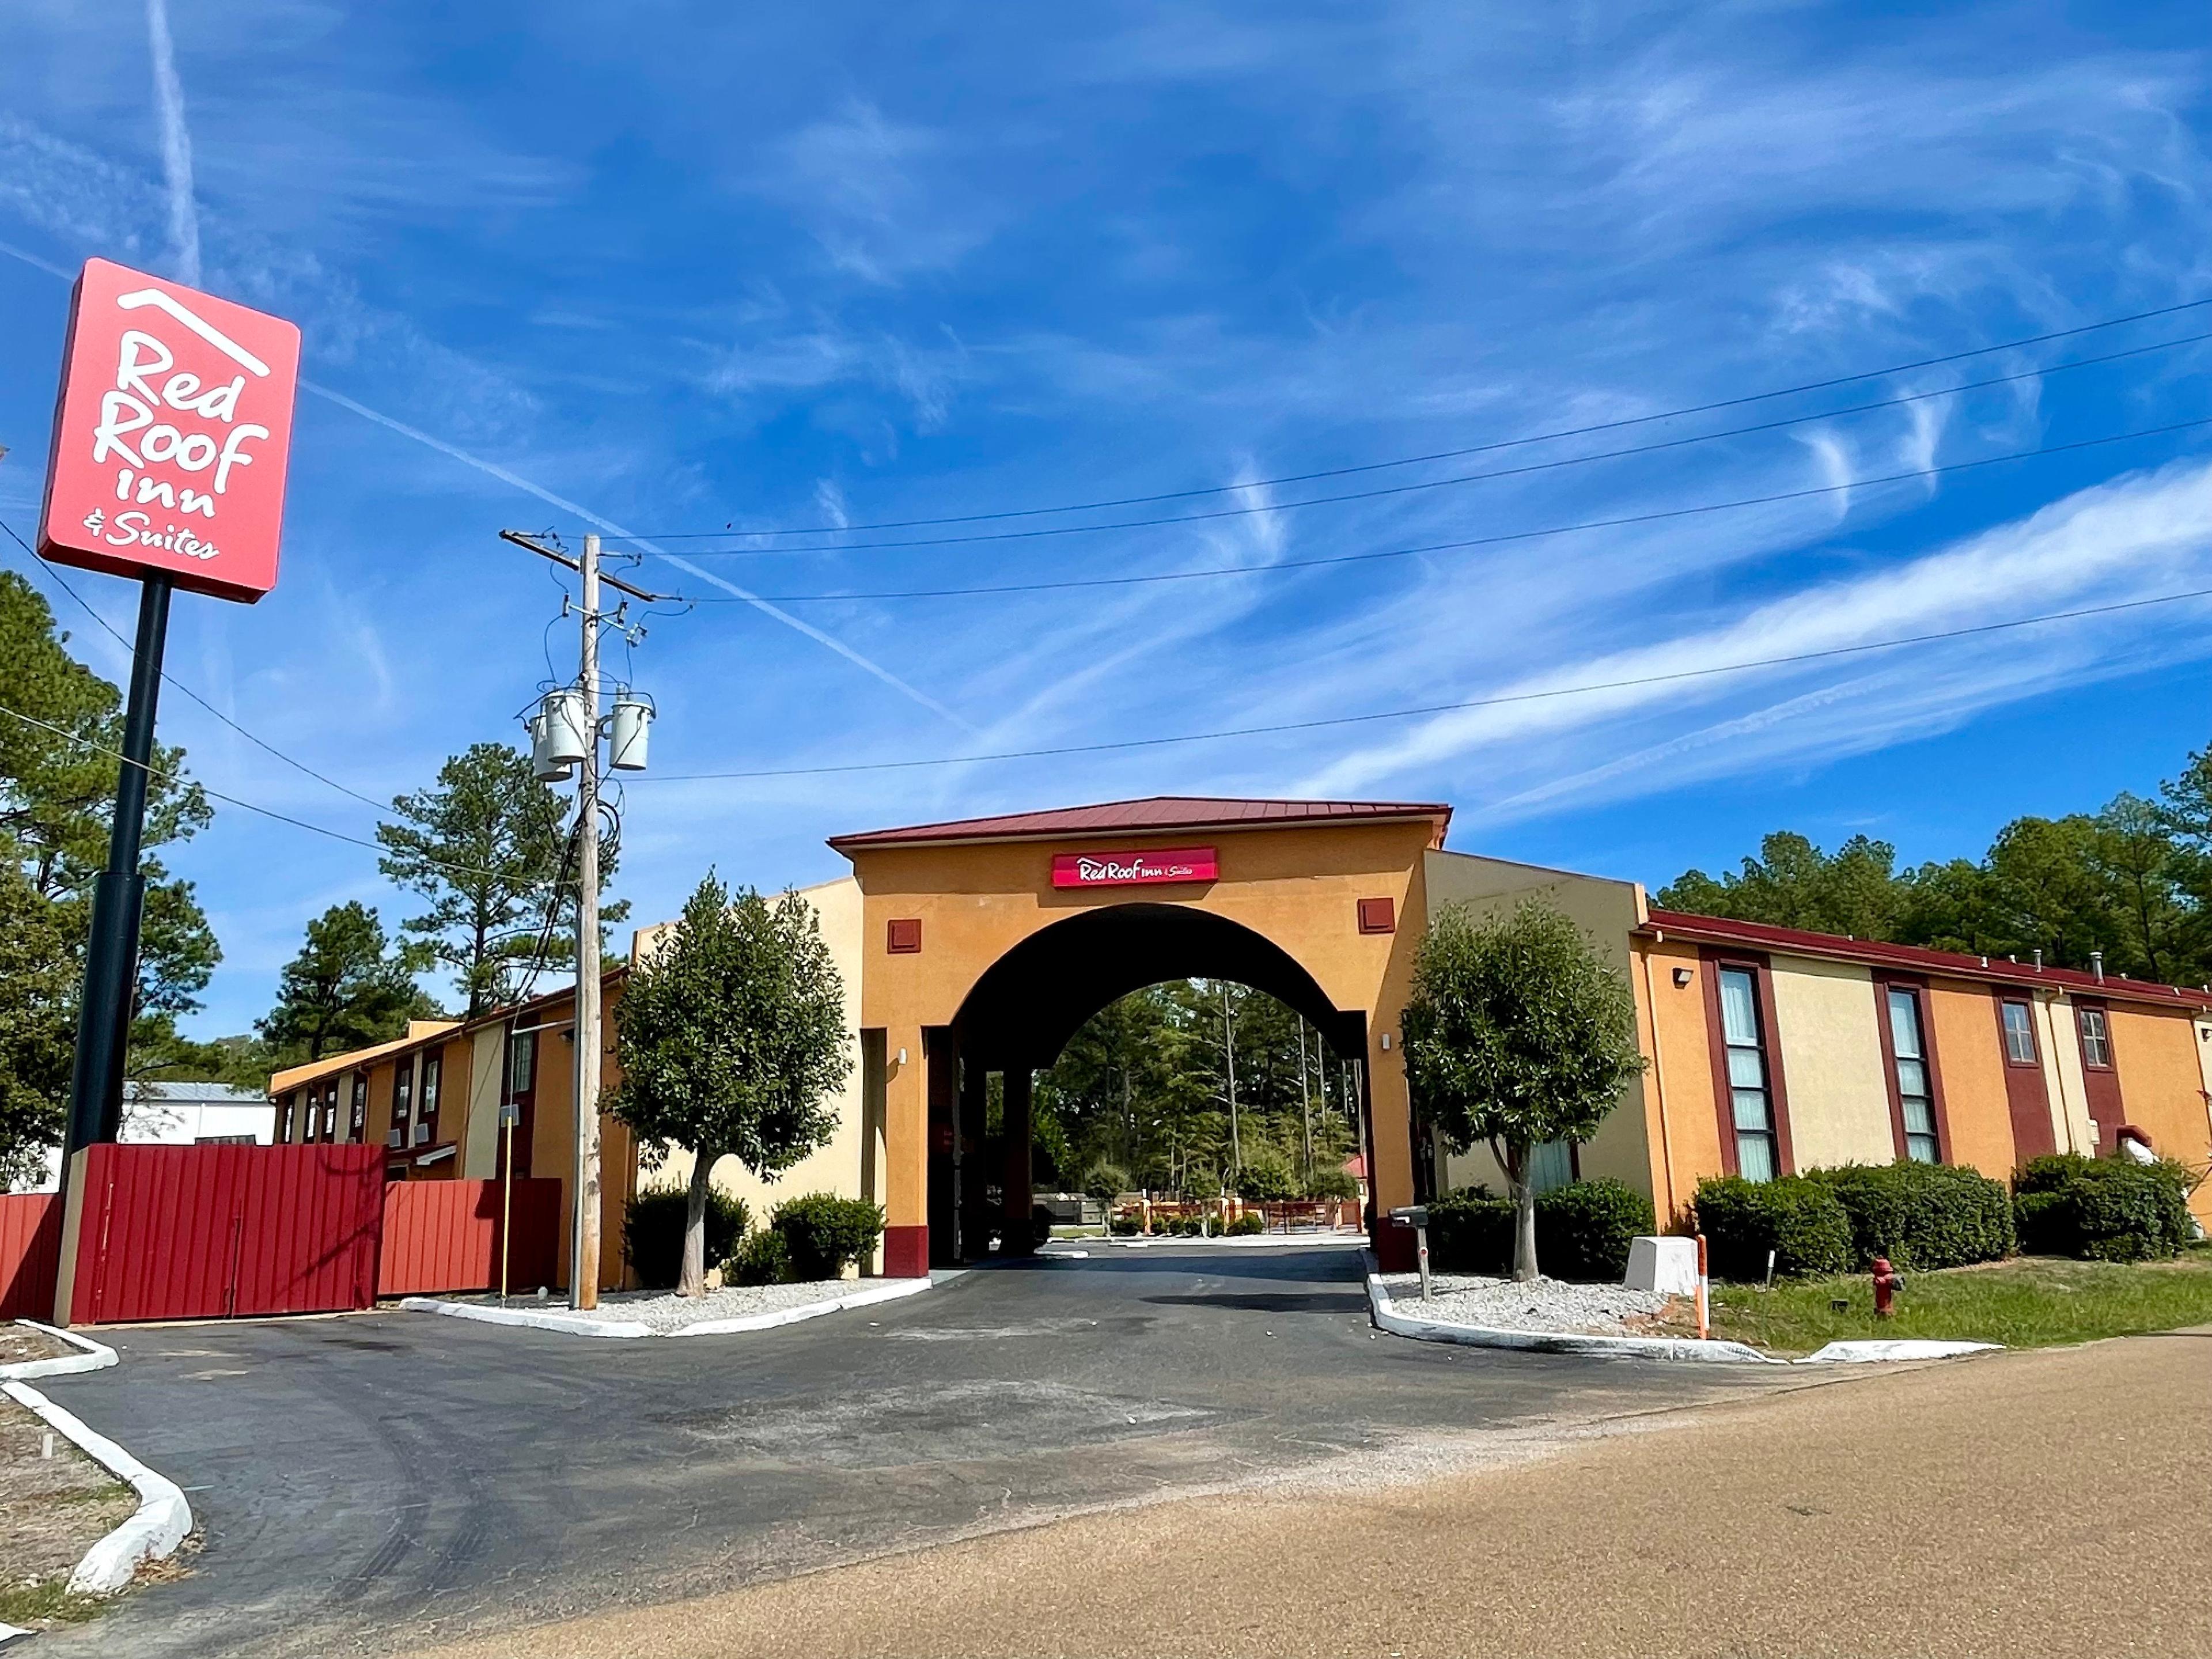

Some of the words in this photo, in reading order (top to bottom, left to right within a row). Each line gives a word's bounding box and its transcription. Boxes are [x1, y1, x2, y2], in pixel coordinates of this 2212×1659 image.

[118, 331, 246, 422] Red
[93, 391, 270, 494] Roof
[116, 468, 215, 518] Inn
[83, 508, 104, 536] &
[105, 511, 219, 560] Suites
[1080, 864, 1107, 881] Red
[1108, 858, 1143, 880] Roof
[1141, 868, 1163, 877] Inn
